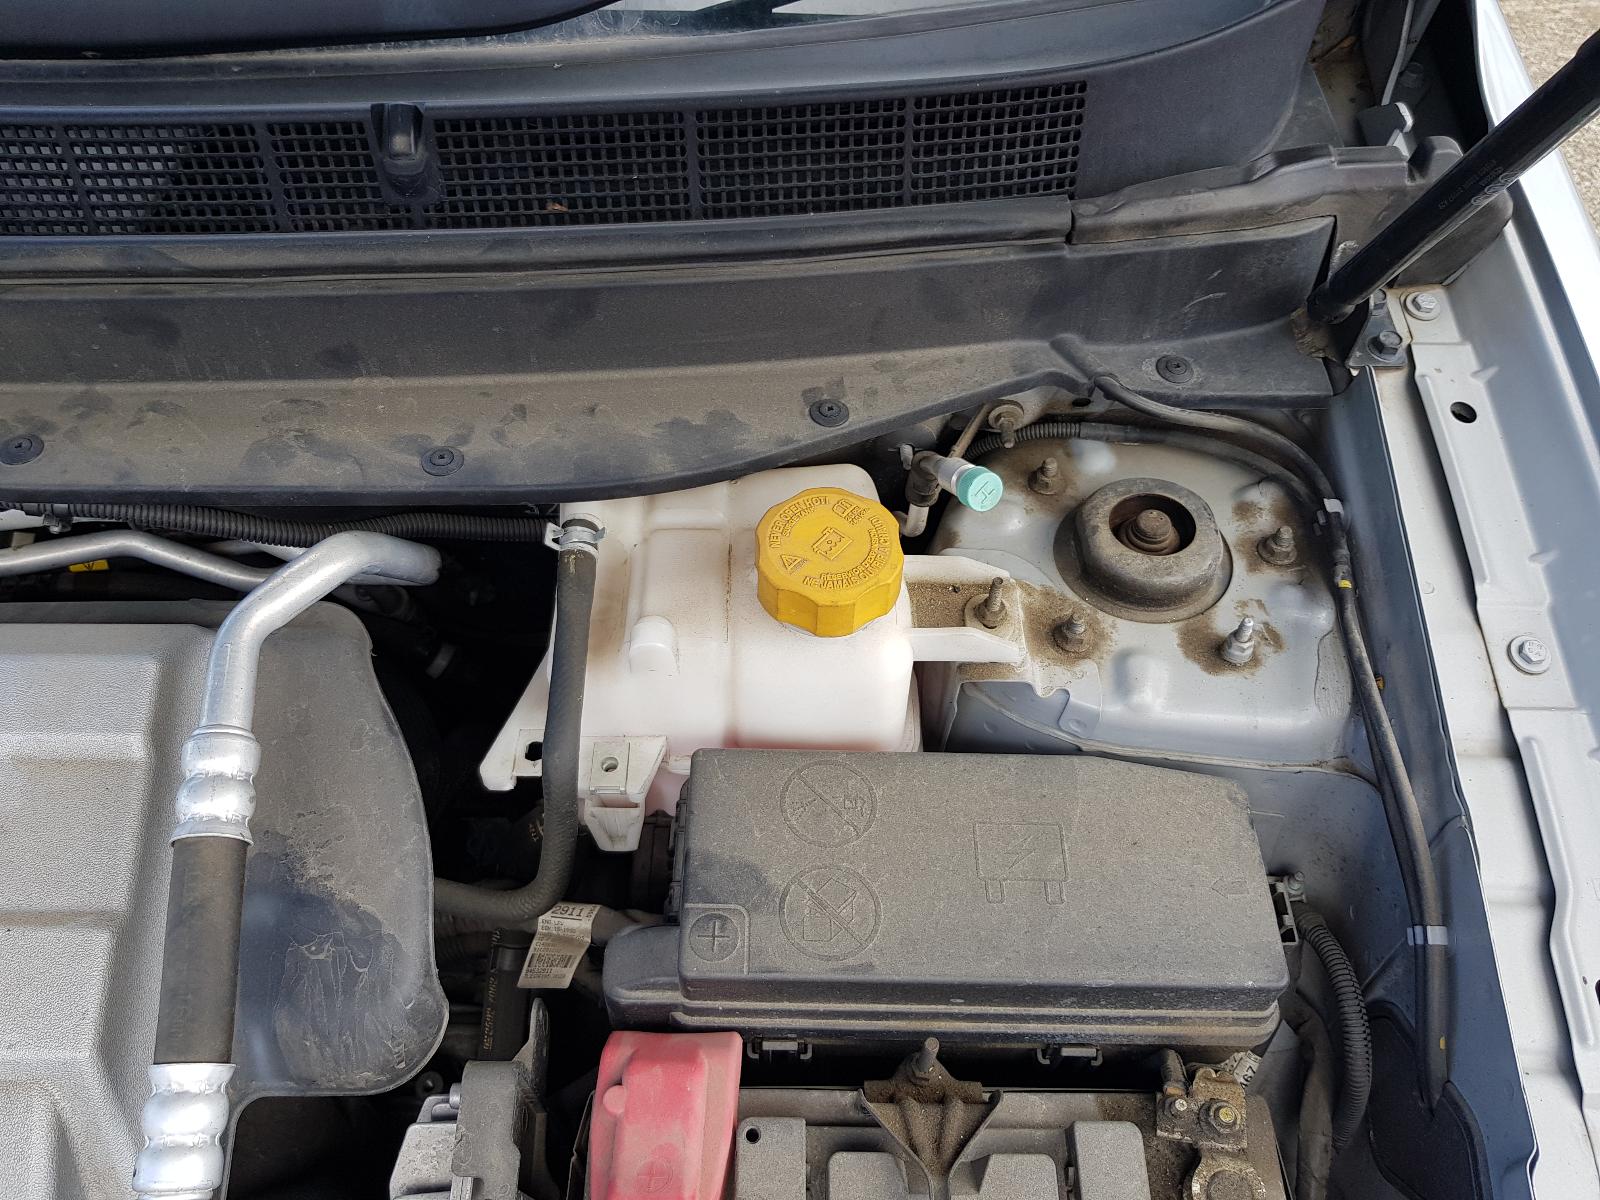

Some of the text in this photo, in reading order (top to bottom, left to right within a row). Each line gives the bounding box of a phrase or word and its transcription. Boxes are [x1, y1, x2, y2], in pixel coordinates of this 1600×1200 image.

[769, 496, 830, 548] NEVER OPEN HOT!
[819, 575, 860, 590] JAMAIS
[551, 905, 584, 918] 2911
